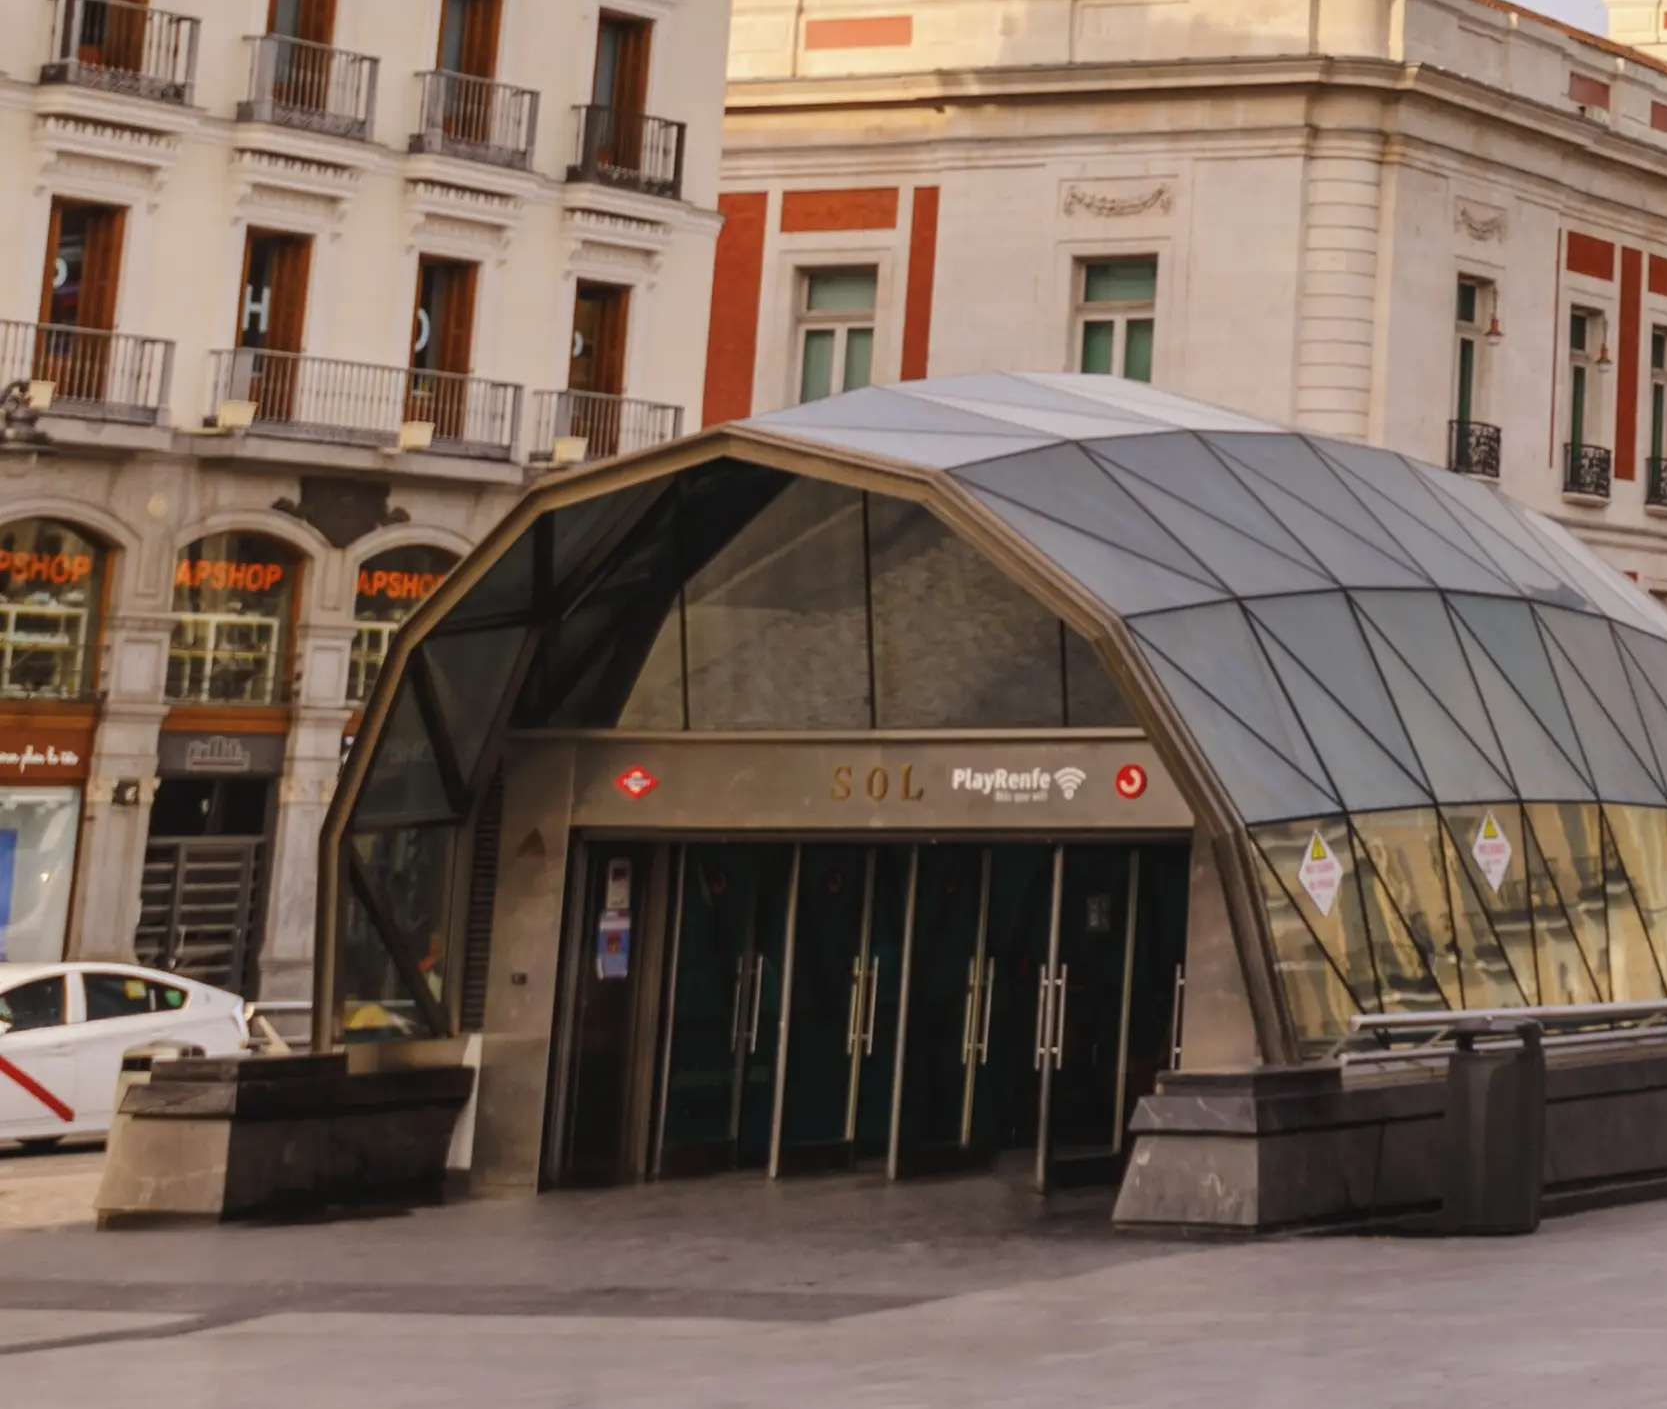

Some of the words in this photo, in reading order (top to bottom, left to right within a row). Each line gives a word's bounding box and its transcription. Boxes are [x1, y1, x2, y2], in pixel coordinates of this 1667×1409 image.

[174, 558, 283, 592] APSHOP
[356, 569, 446, 599] APSHO
[830, 763, 924, 802] SOL
[952, 767, 1051, 795] PlayRenfe
